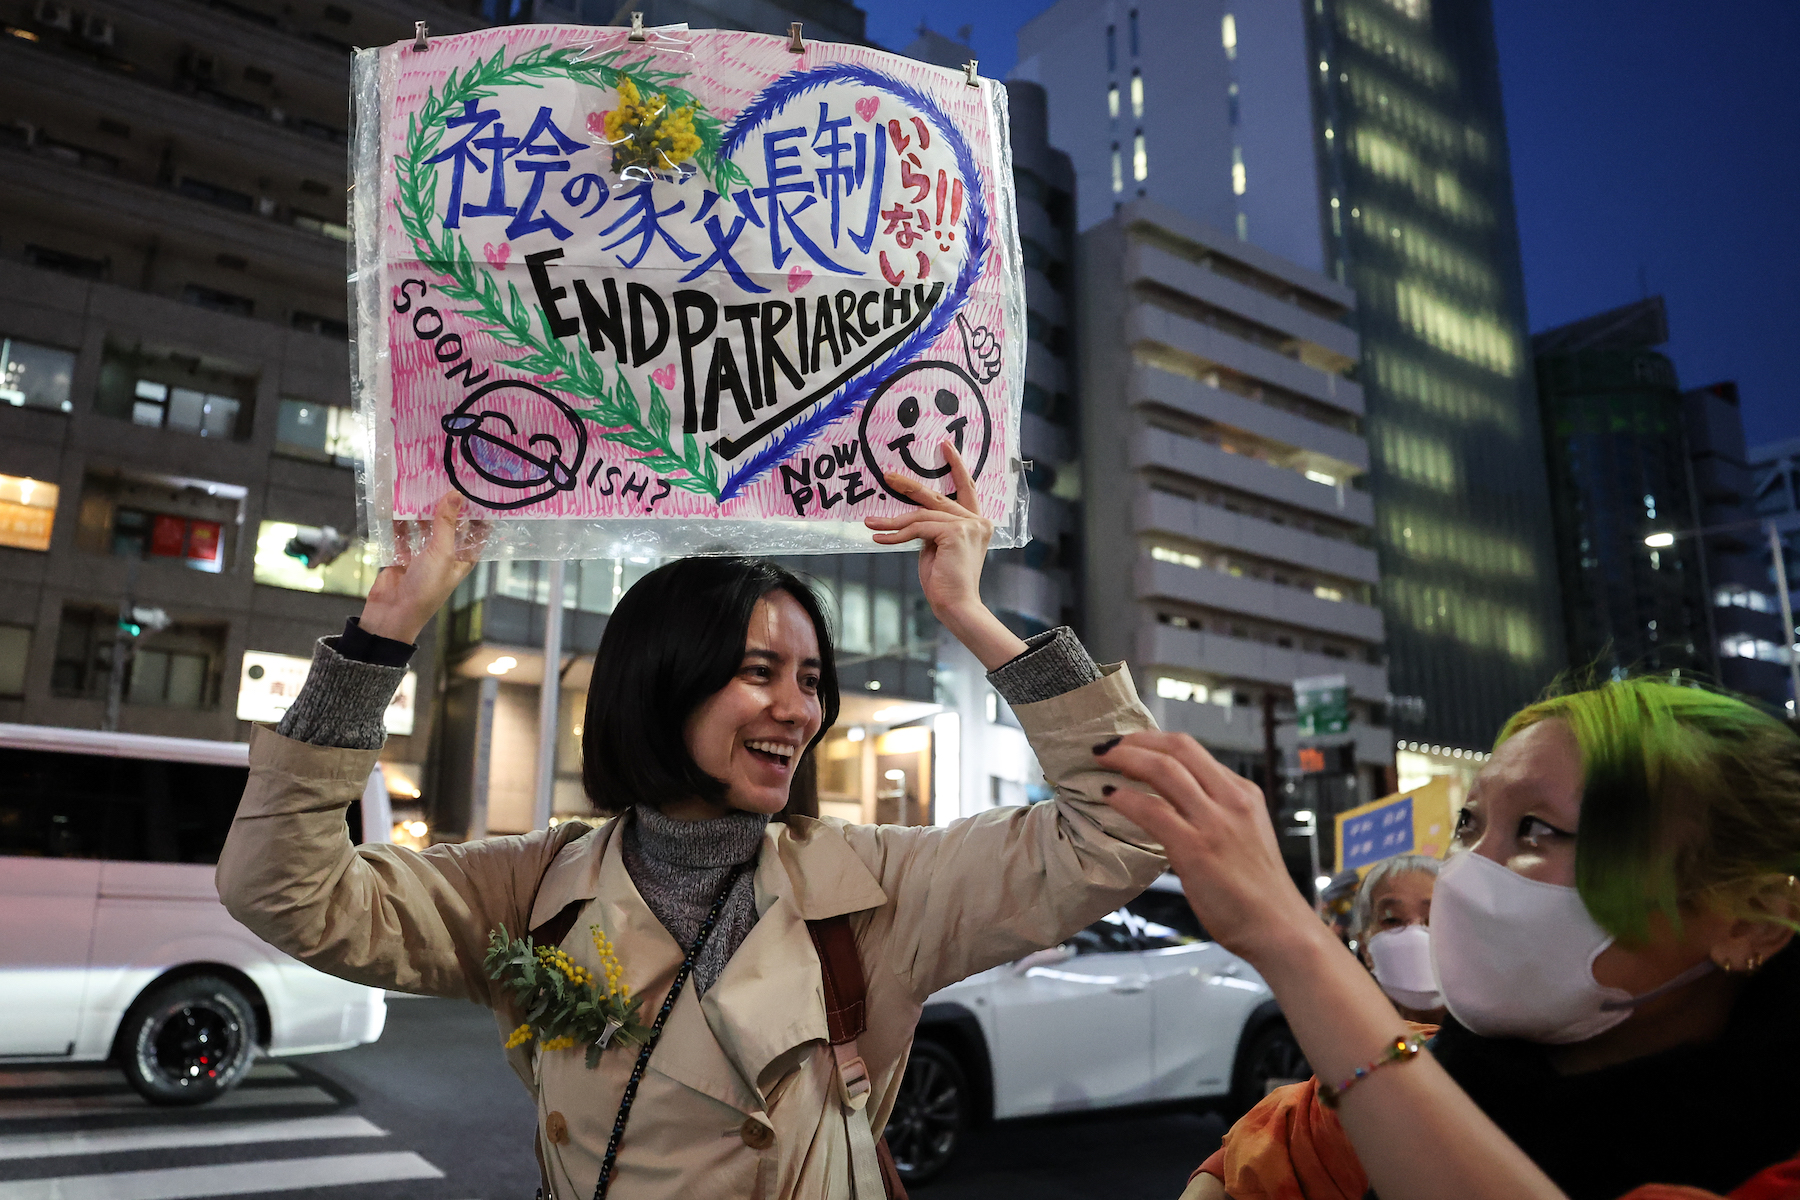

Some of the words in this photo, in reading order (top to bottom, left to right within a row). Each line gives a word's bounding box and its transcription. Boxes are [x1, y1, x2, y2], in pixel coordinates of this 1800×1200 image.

[421, 98, 887, 294] 社会の家父長制
[393, 278, 490, 388] SOON
[524, 247, 671, 368] END
[672, 281, 945, 434] PATRIARCHY
[779, 439, 859, 495] NOW
